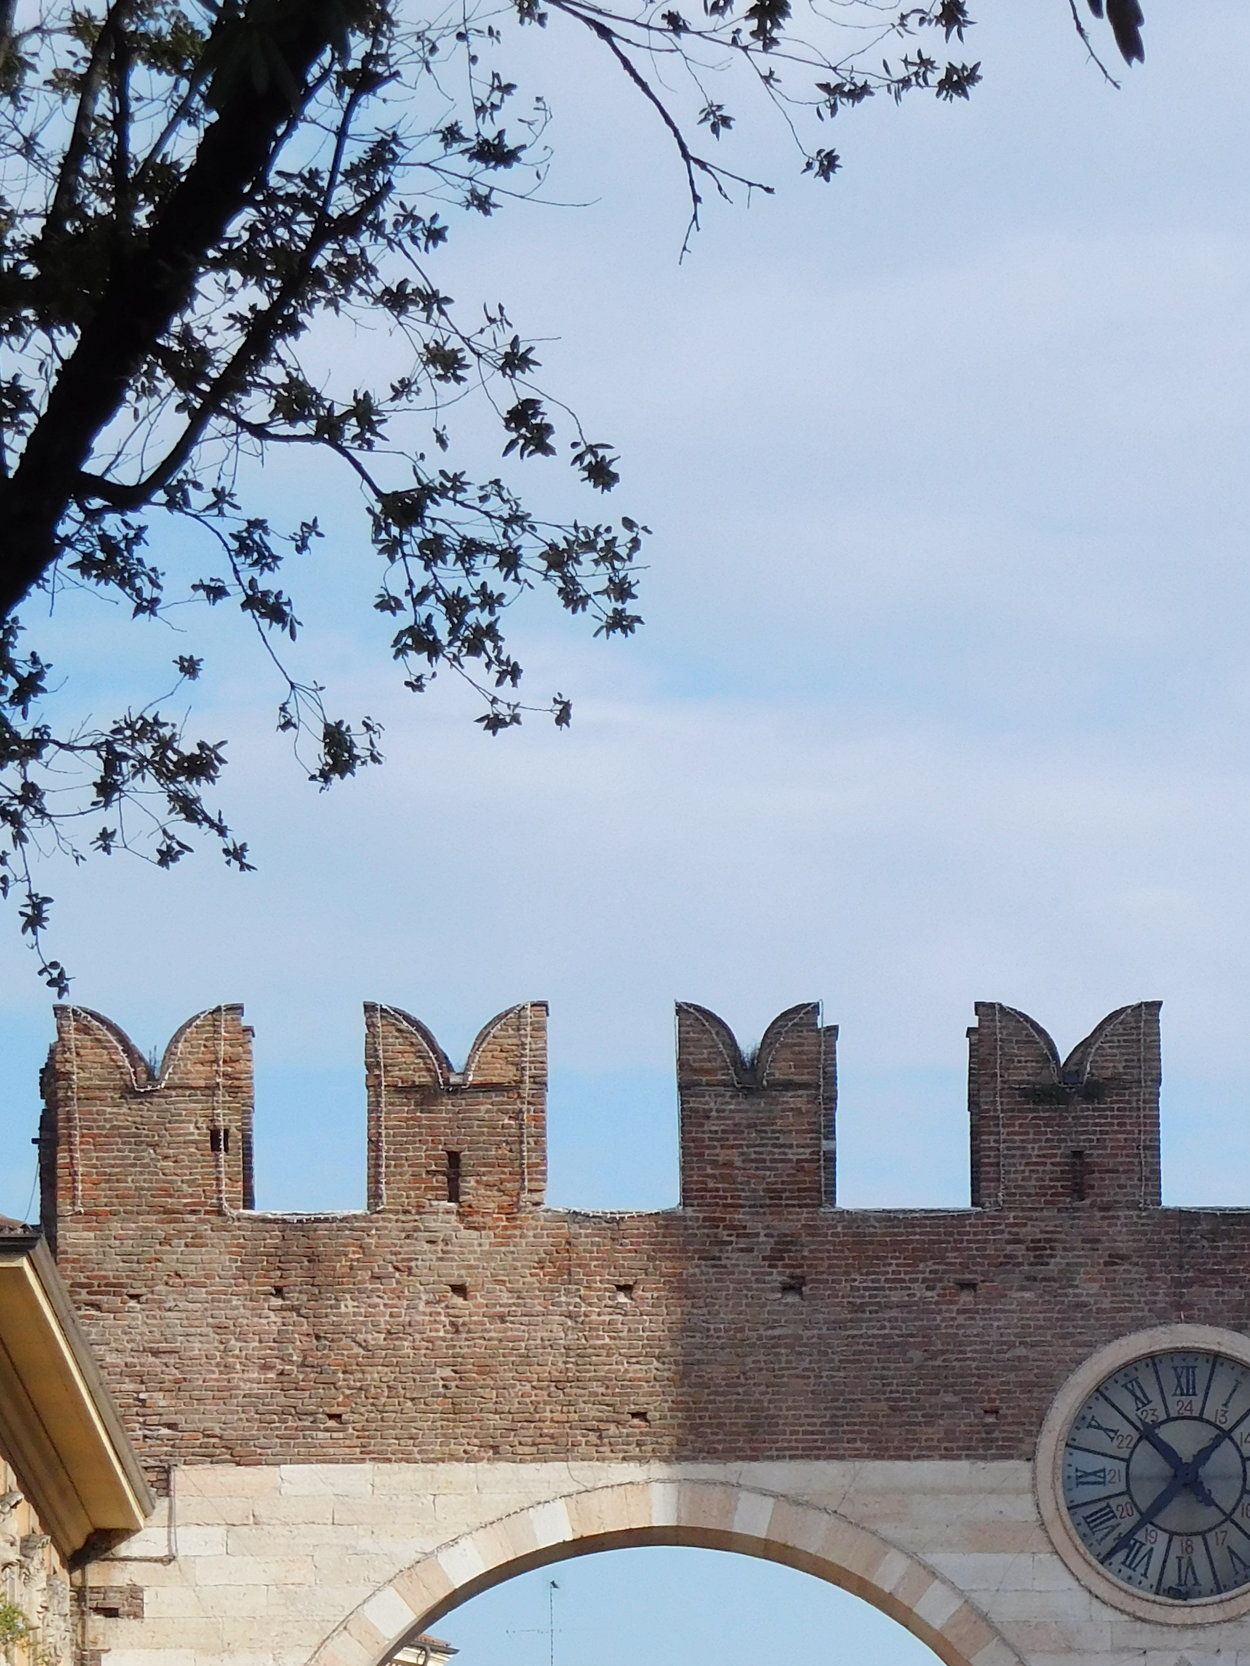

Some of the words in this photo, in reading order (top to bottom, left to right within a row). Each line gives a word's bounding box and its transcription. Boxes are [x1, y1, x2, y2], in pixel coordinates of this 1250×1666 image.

[1172, 1366, 1198, 1396] XII
[1177, 1400, 1194, 1414] 24
[1141, 1410, 1159, 1424] 23
[1214, 1409, 1228, 1424] 13
[1116, 1434, 1133, 1448] 22
[1076, 1468, 1106, 1486] IX
[1108, 1468, 1121, 1483] 21
[1116, 1503, 1134, 1518] 20
[1144, 1528, 1157, 1543] 19
[1214, 1531, 1227, 1546] 17
[1180, 1540, 1193, 1554] 18
[1176, 1555, 1200, 1586] VI
